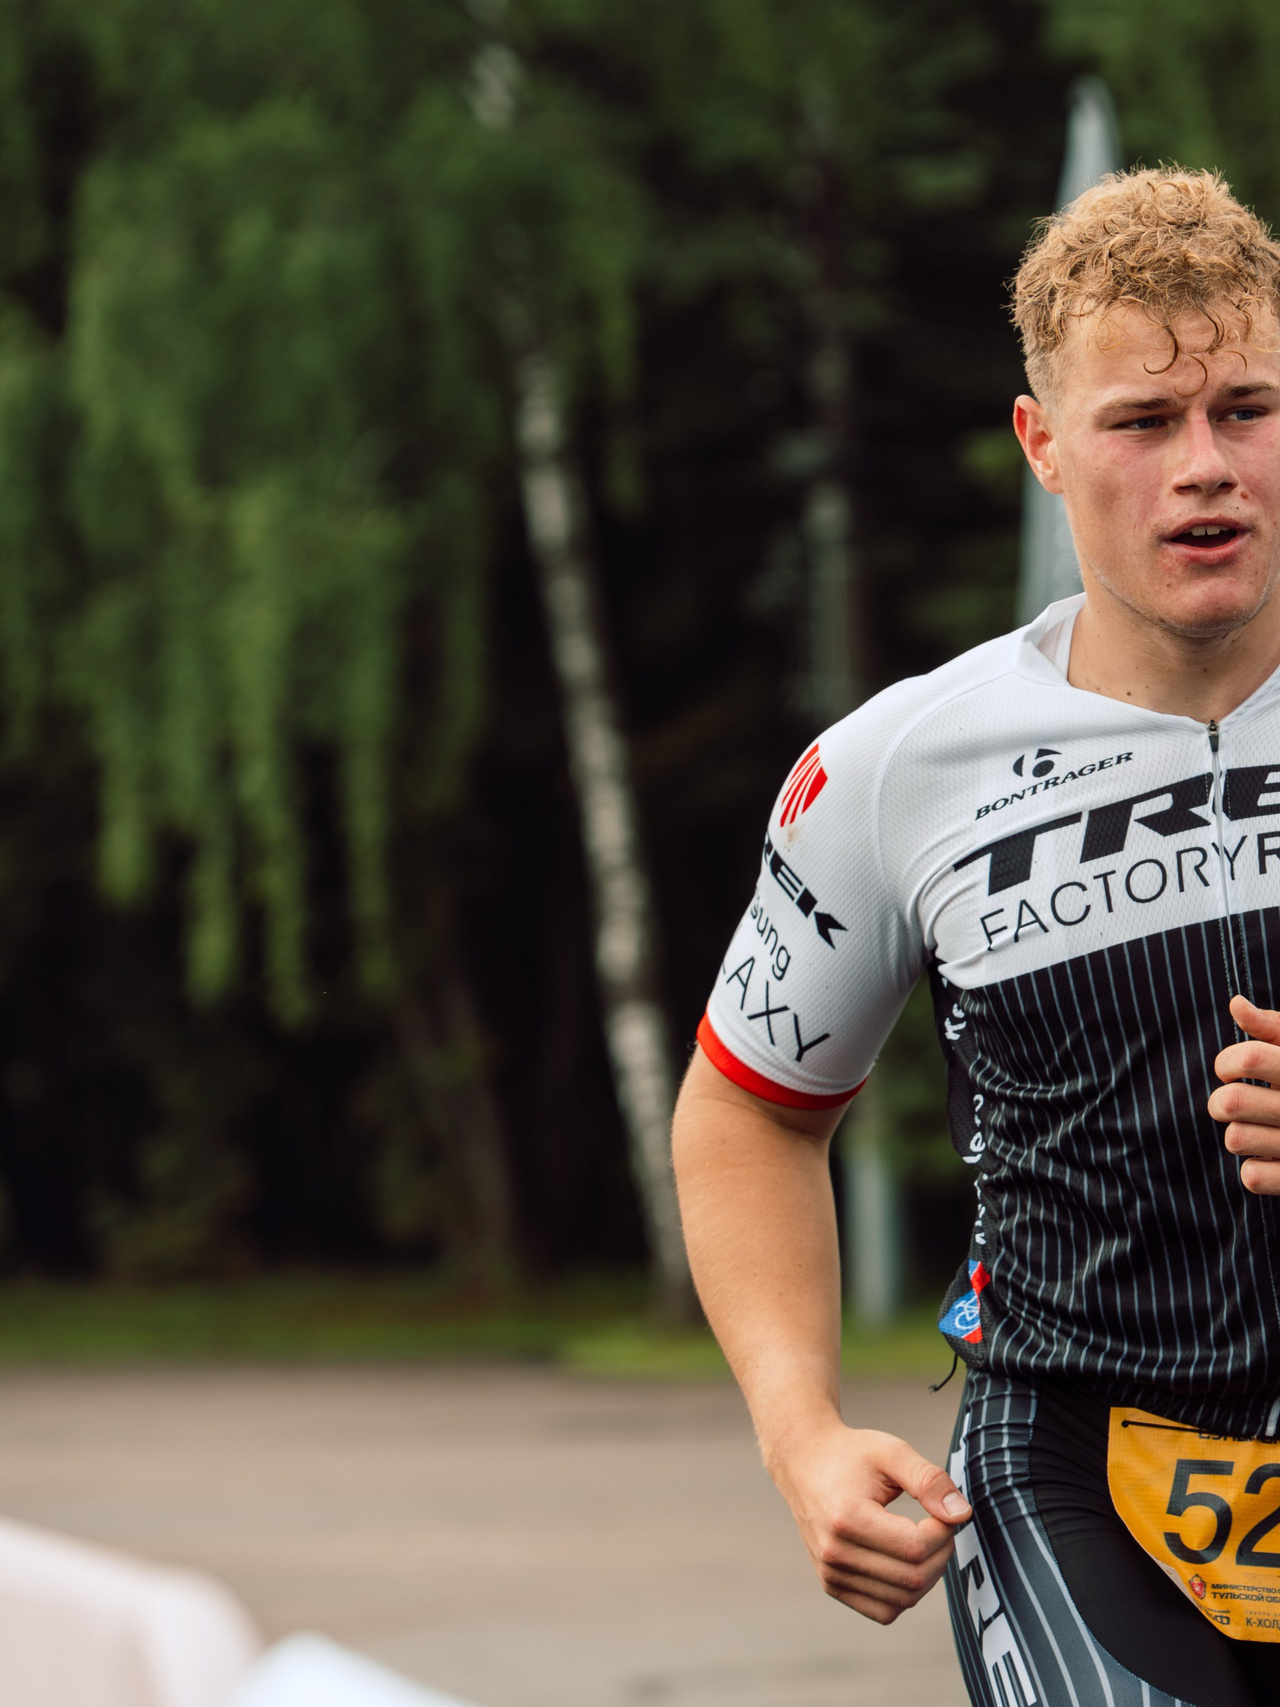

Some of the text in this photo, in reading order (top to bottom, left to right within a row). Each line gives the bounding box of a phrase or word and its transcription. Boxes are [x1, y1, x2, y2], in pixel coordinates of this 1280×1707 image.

[975, 752, 1133, 820] BONTRAGER
[722, 955, 831, 1063] AXY
[1211, 1583, 1276, 1594] МИНИСТЕРСТВО
[1211, 1591, 1265, 1602] ТУЛЬСКОЙ
